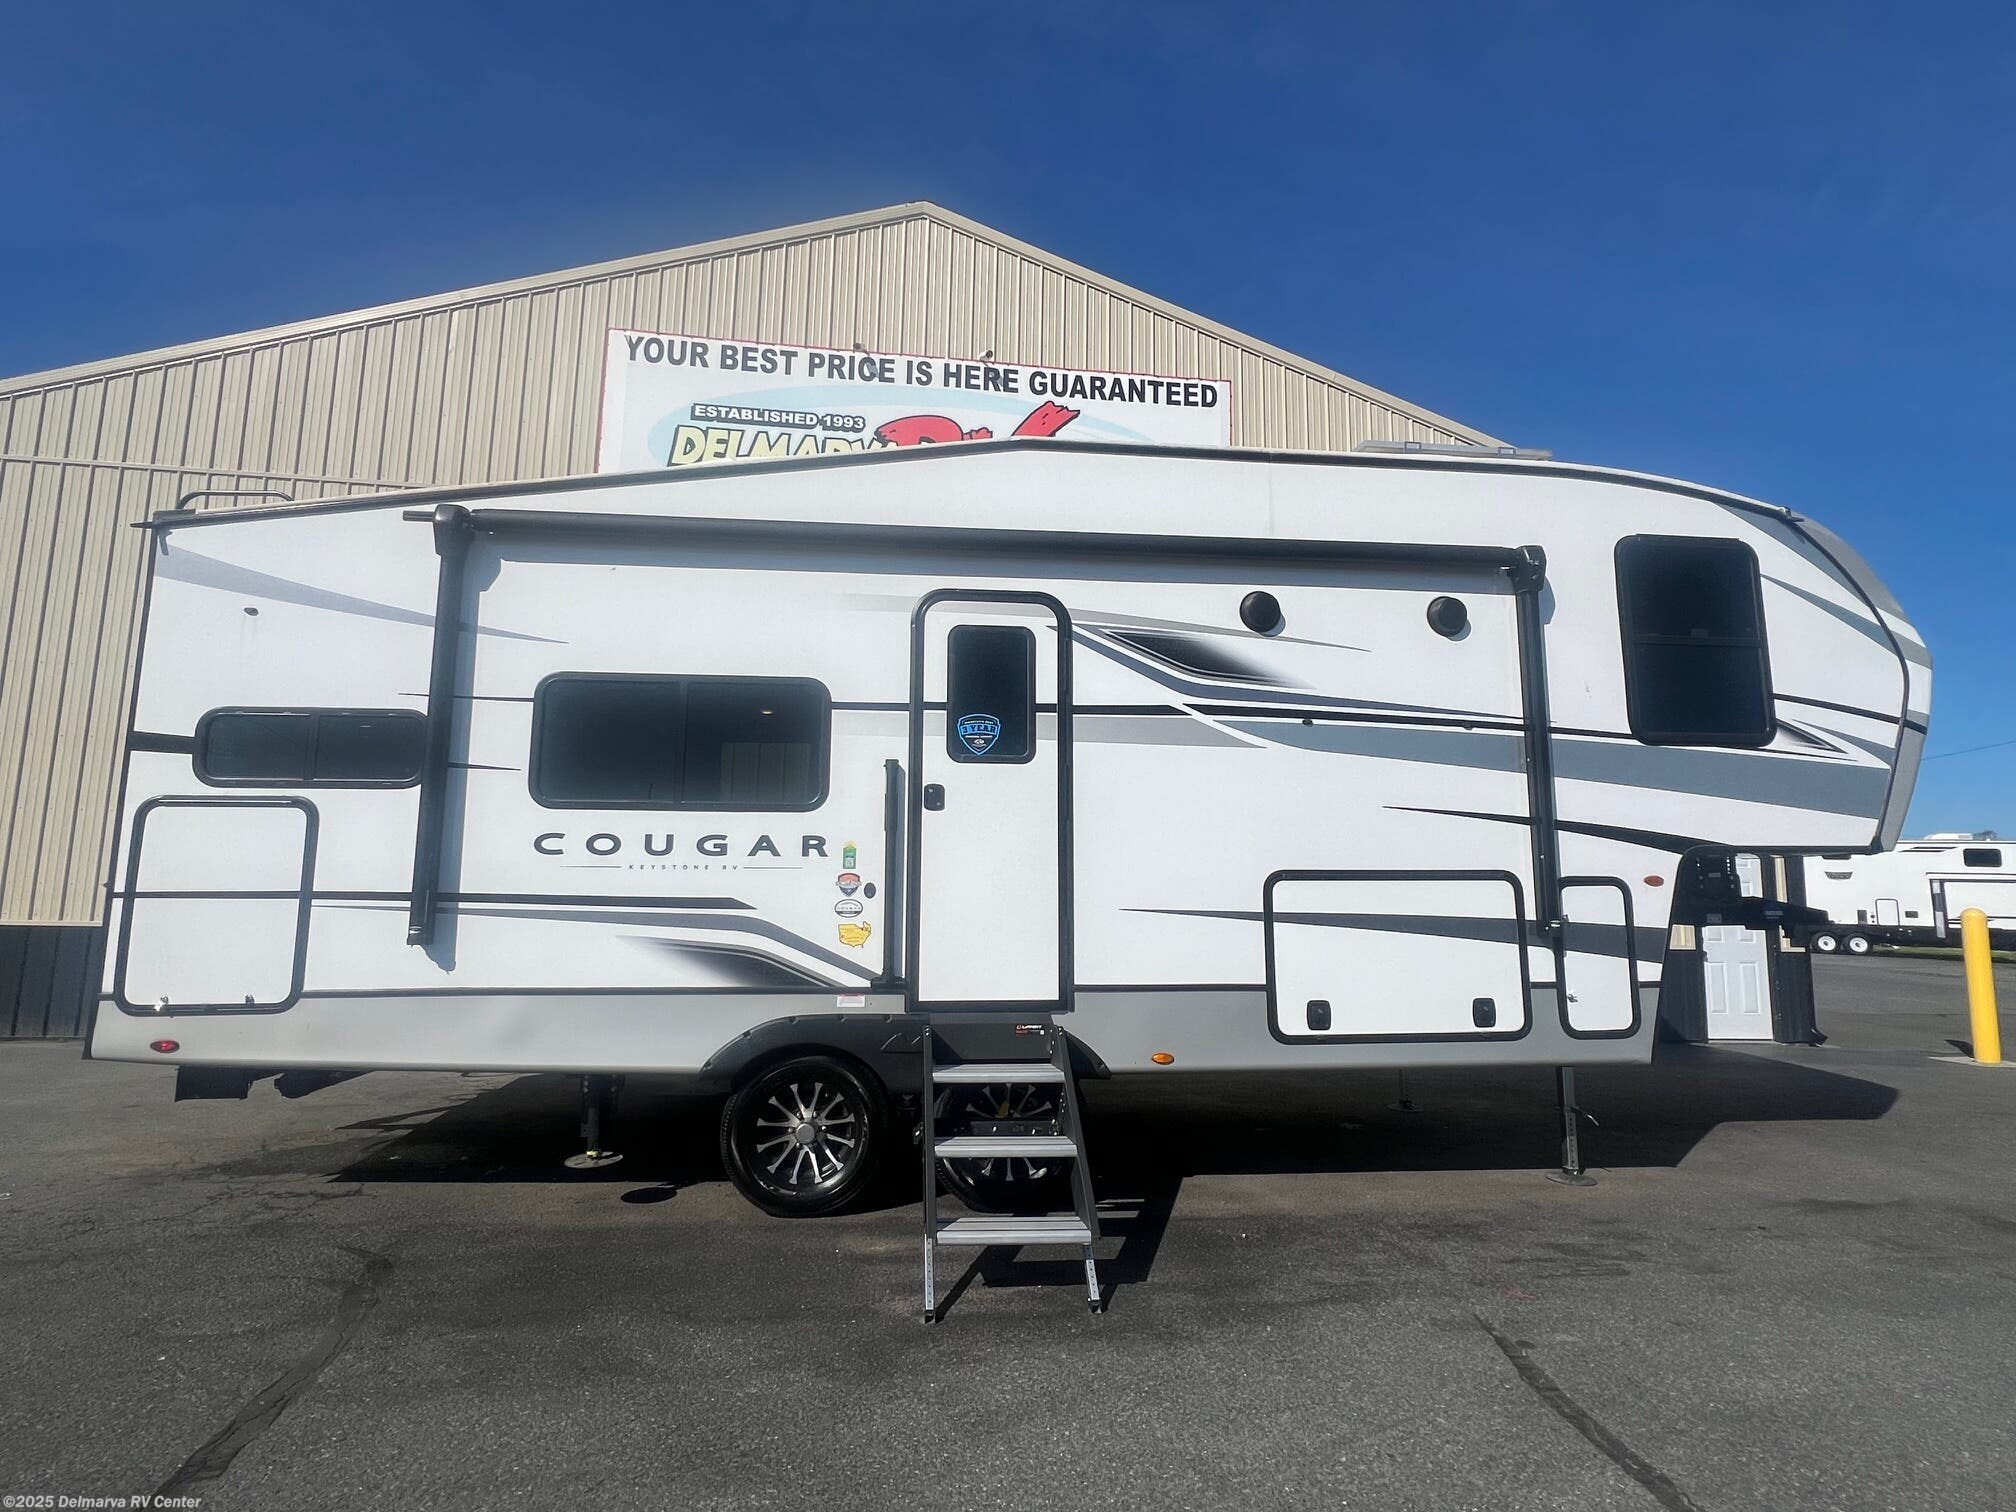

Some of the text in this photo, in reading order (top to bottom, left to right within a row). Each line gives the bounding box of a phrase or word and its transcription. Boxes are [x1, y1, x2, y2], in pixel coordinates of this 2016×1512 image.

[624, 335, 1218, 408] YOUR BEST PRICE IS HERE GUARANTEED
[694, 404, 818, 426] ESTABLISHED
[823, 415, 865, 429] 1993
[533, 832, 829, 857] COUGAR
